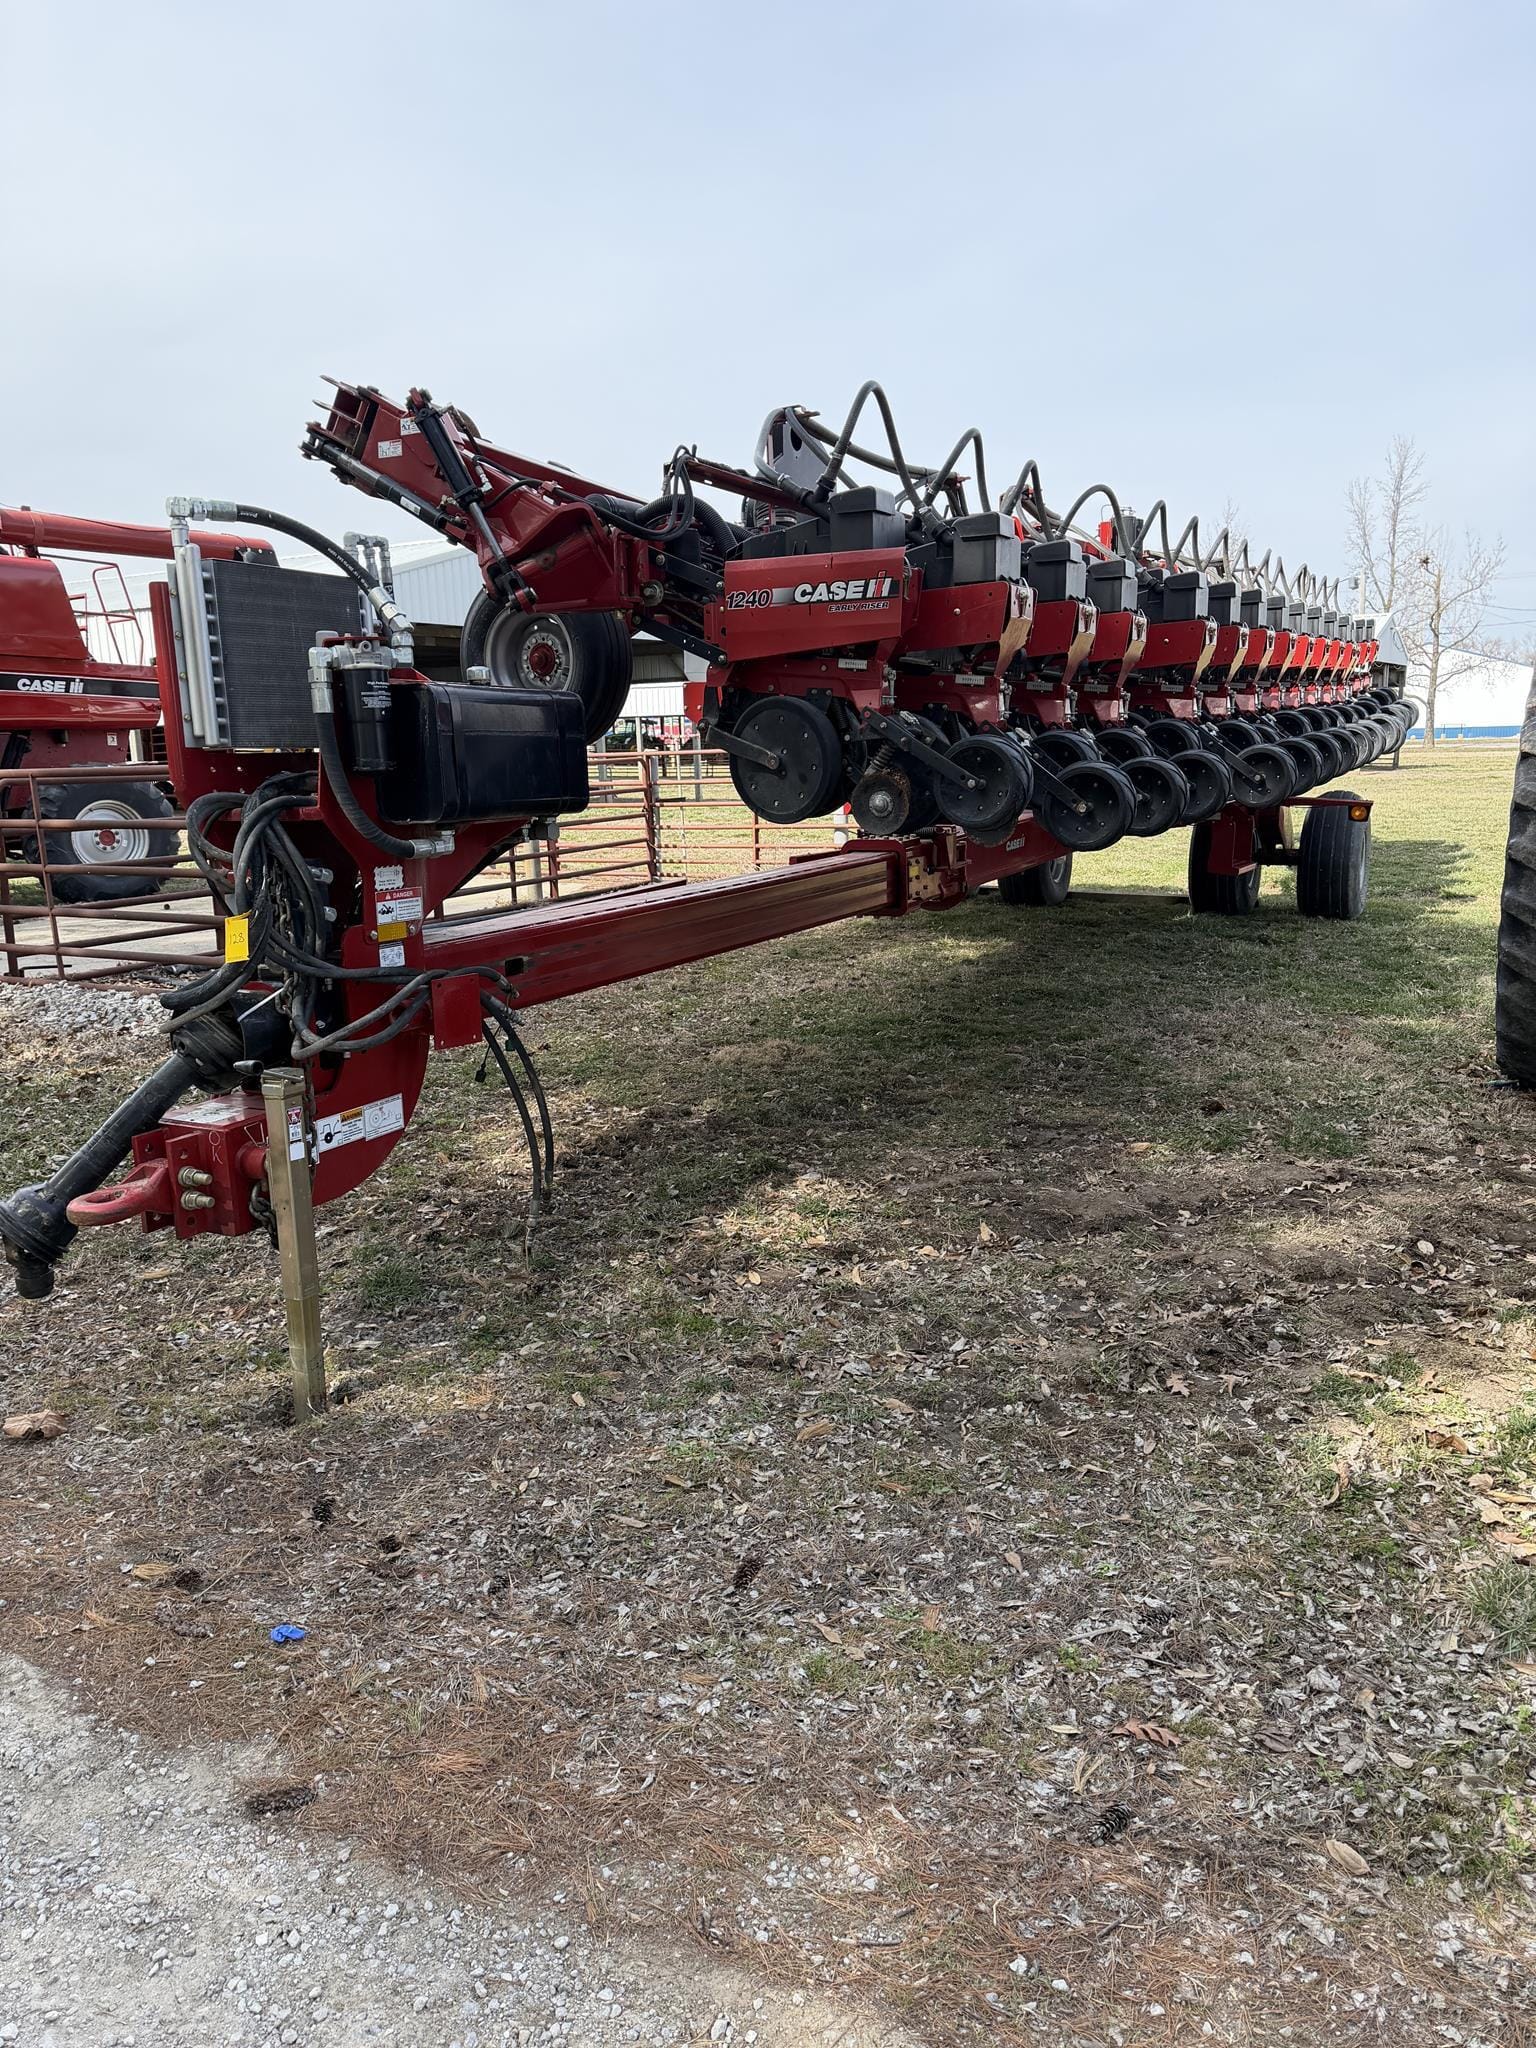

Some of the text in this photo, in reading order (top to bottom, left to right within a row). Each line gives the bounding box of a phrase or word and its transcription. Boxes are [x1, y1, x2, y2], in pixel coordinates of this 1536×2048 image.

[726, 588, 772, 610] 1240
[793, 579, 866, 603] CASE
[828, 601, 889, 612] EARLY RISER
[17, 678, 66, 693] CASE
[392, 890, 413, 898] DANGER
[229, 932, 245, 945] 128
